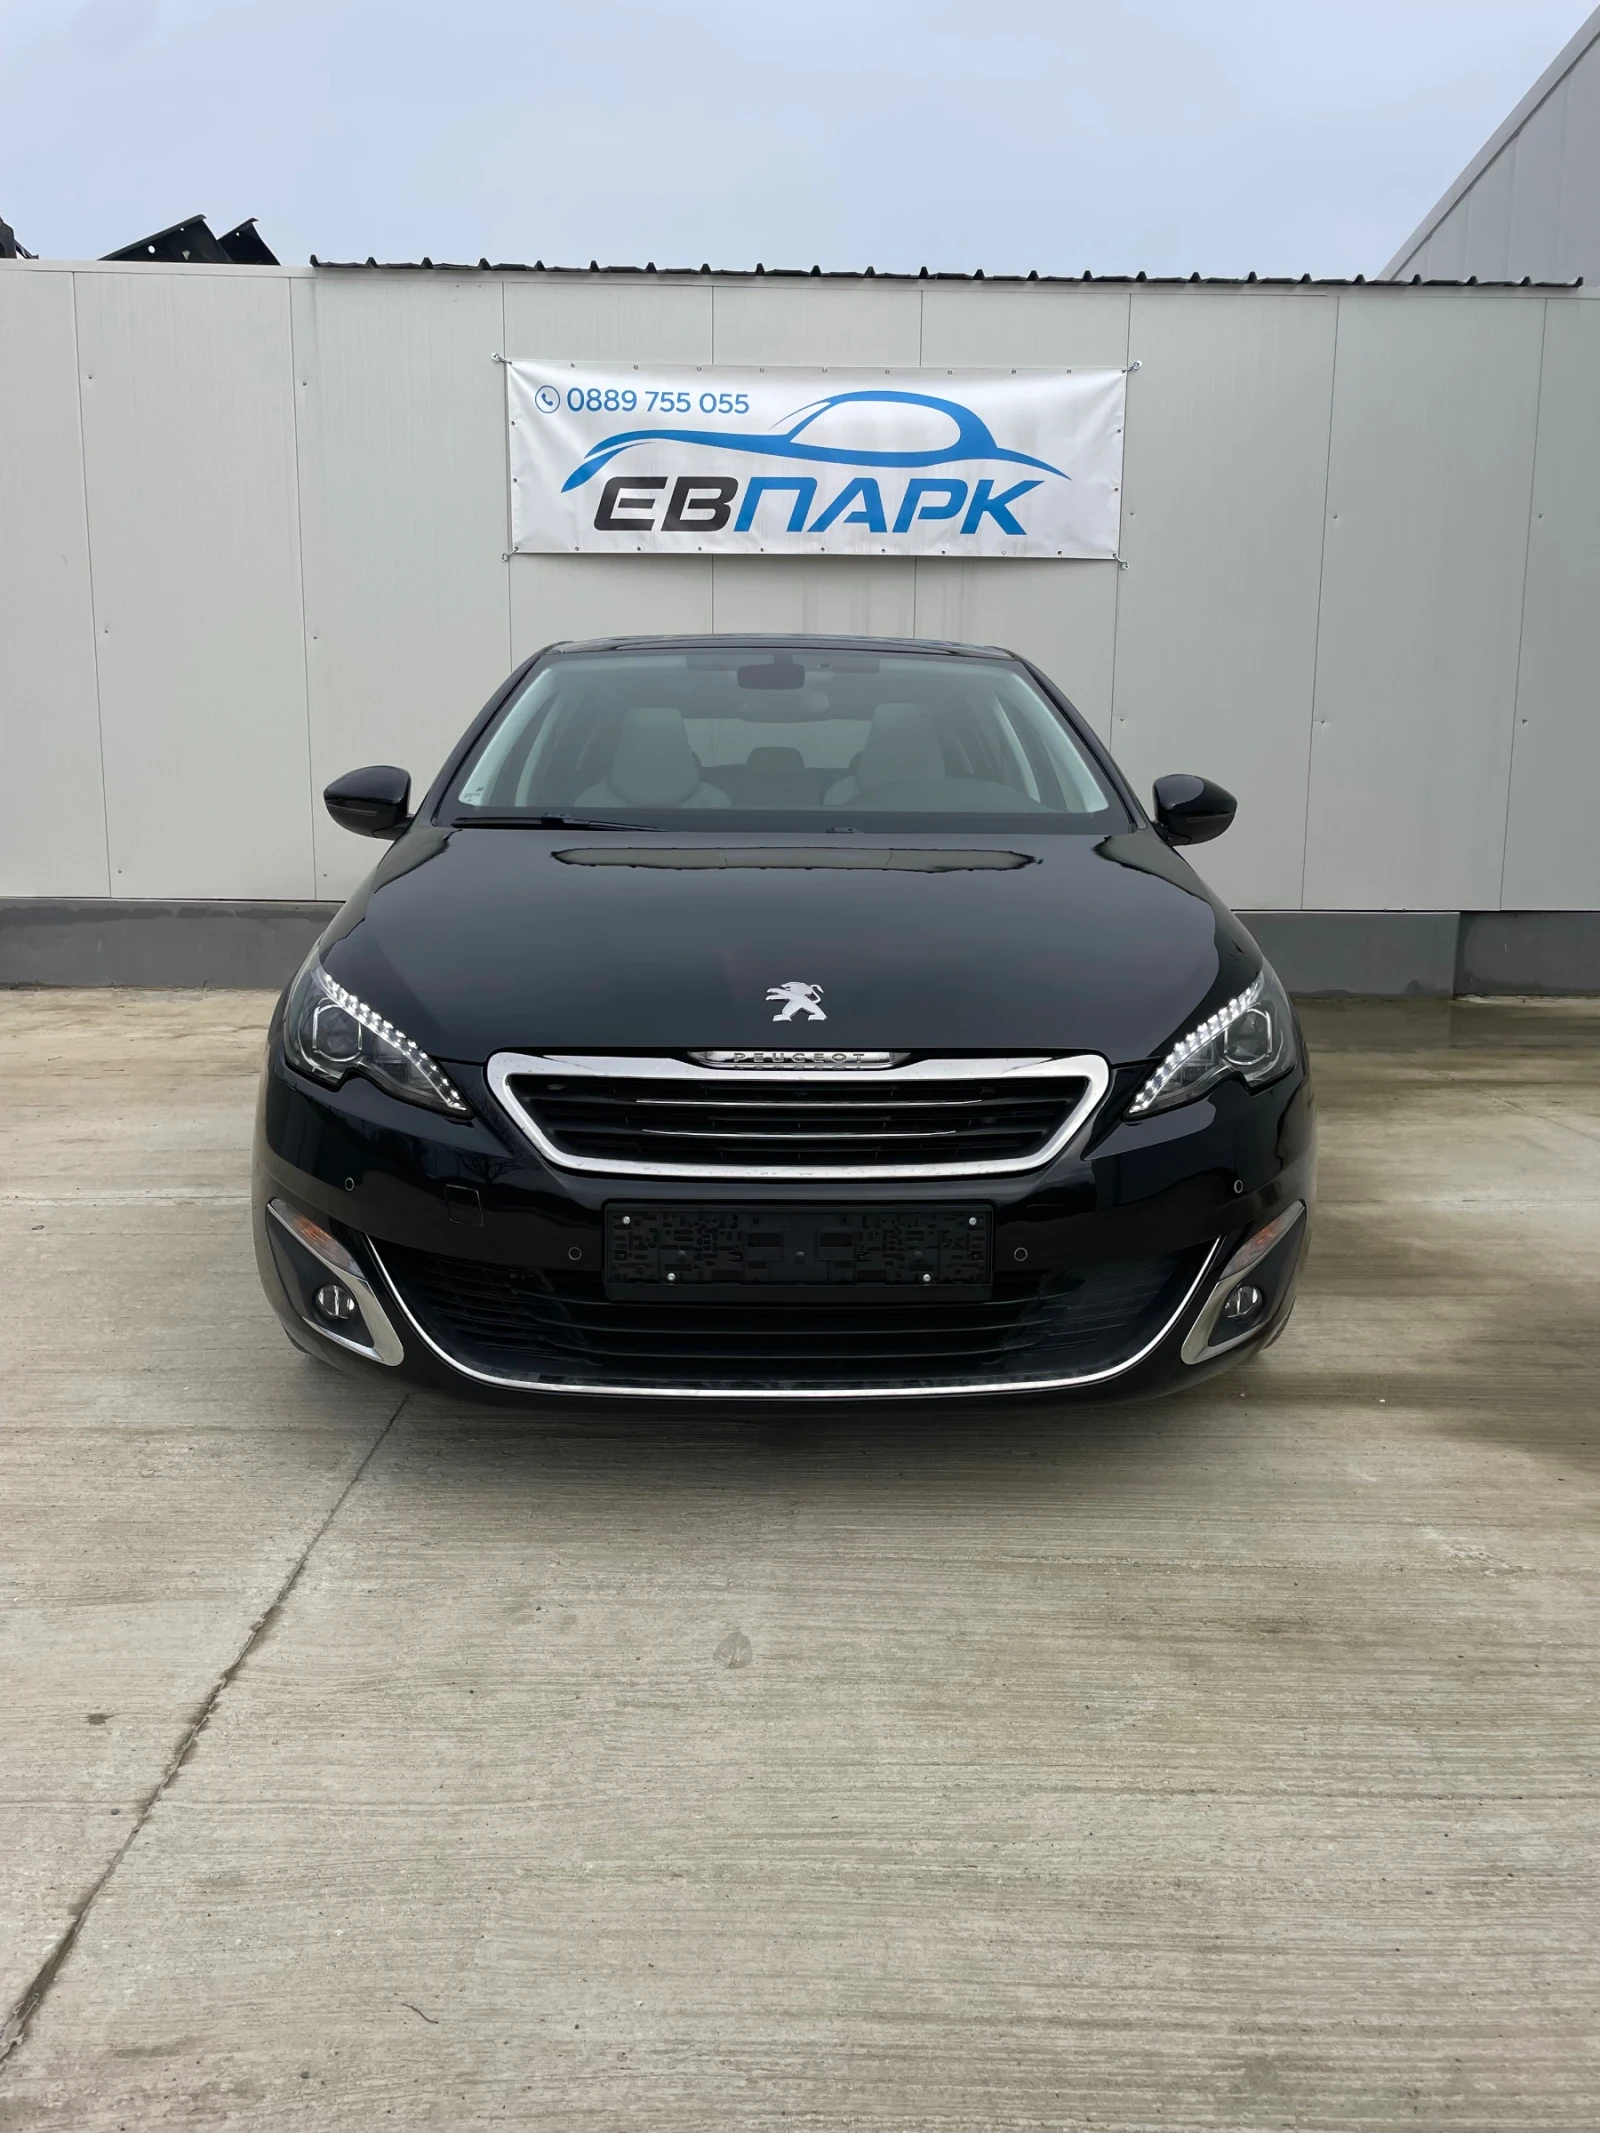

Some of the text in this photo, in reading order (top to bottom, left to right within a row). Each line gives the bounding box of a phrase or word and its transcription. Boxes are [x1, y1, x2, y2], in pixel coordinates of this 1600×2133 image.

[566, 387, 750, 414] 0889 755 055
[594, 476, 1045, 535] ЕВПАРК
[733, 1053, 865, 1063] PEUGEOT
